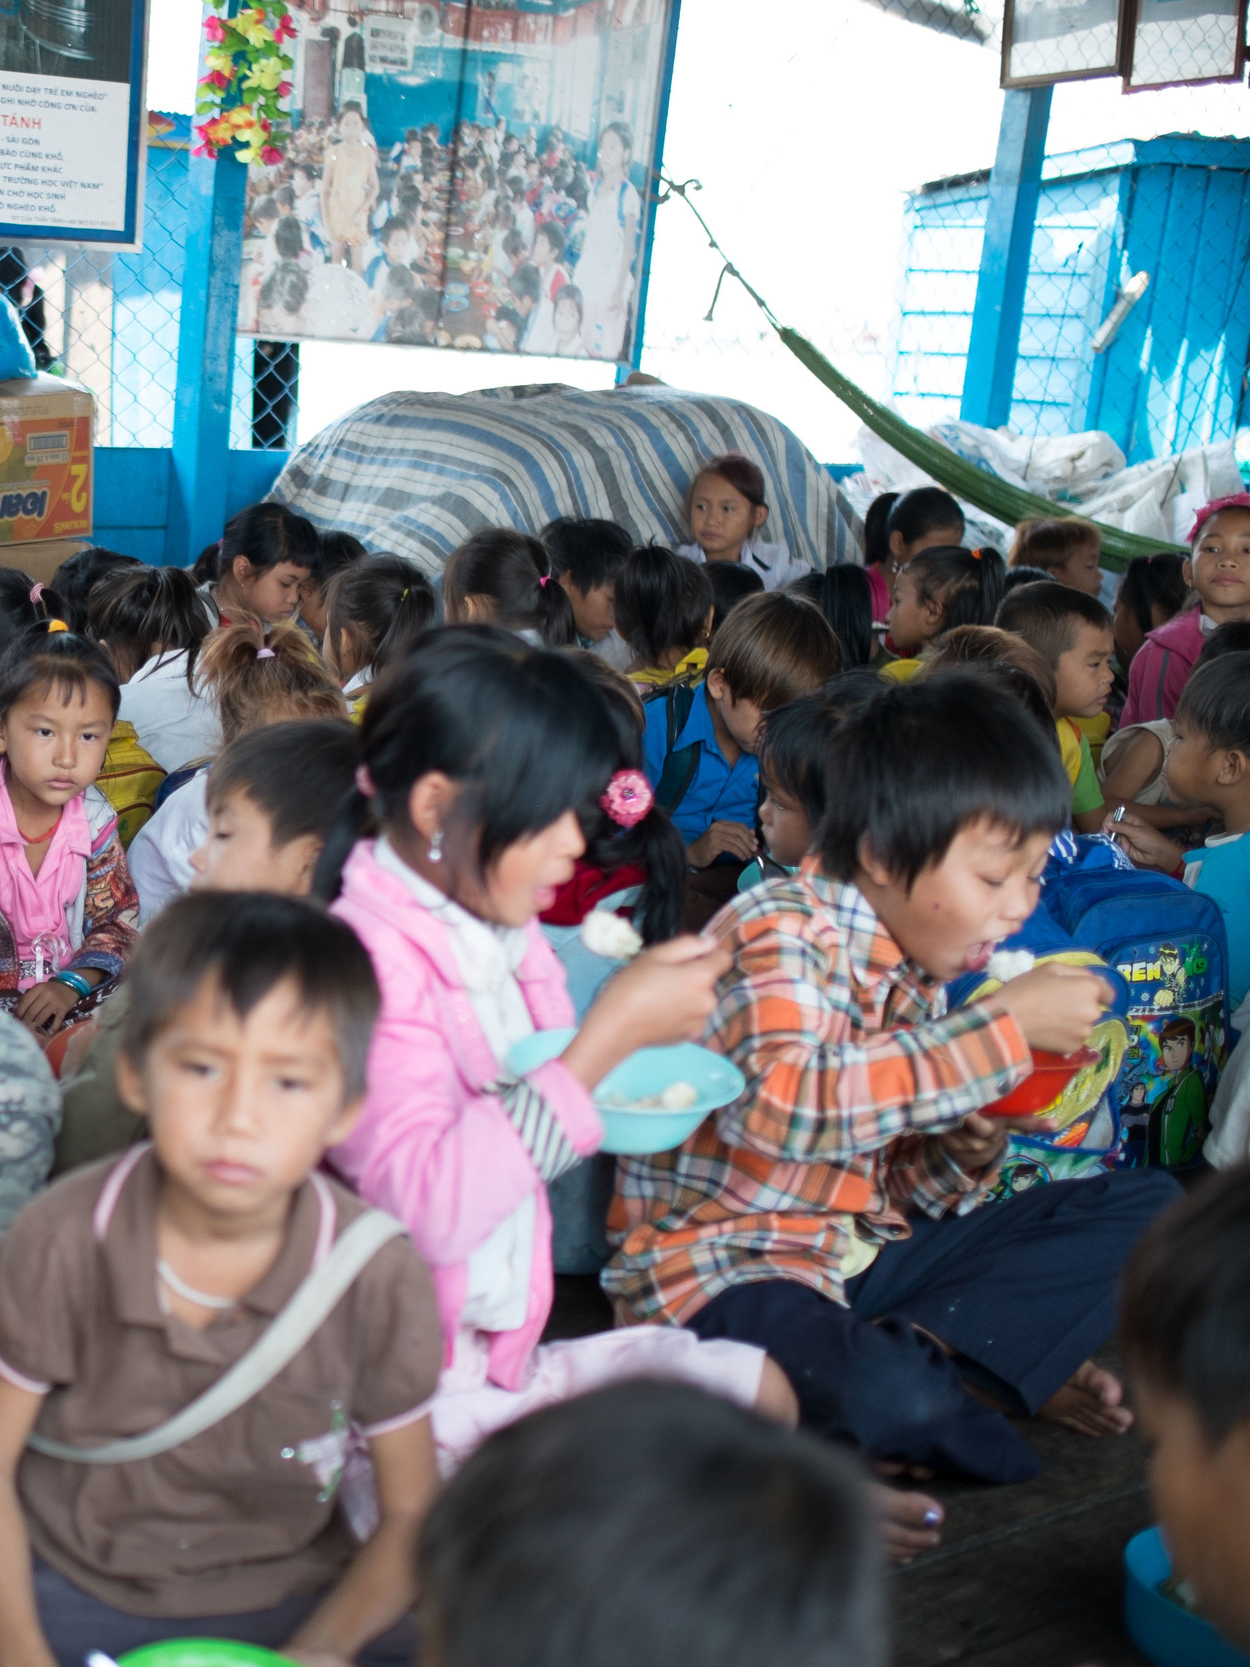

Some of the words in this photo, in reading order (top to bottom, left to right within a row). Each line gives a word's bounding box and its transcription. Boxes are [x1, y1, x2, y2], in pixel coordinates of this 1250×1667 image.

[1, 111, 42, 130] TÁNH
[70, 464, 88, 514] 2
[1116, 961, 1161, 982] BEN
